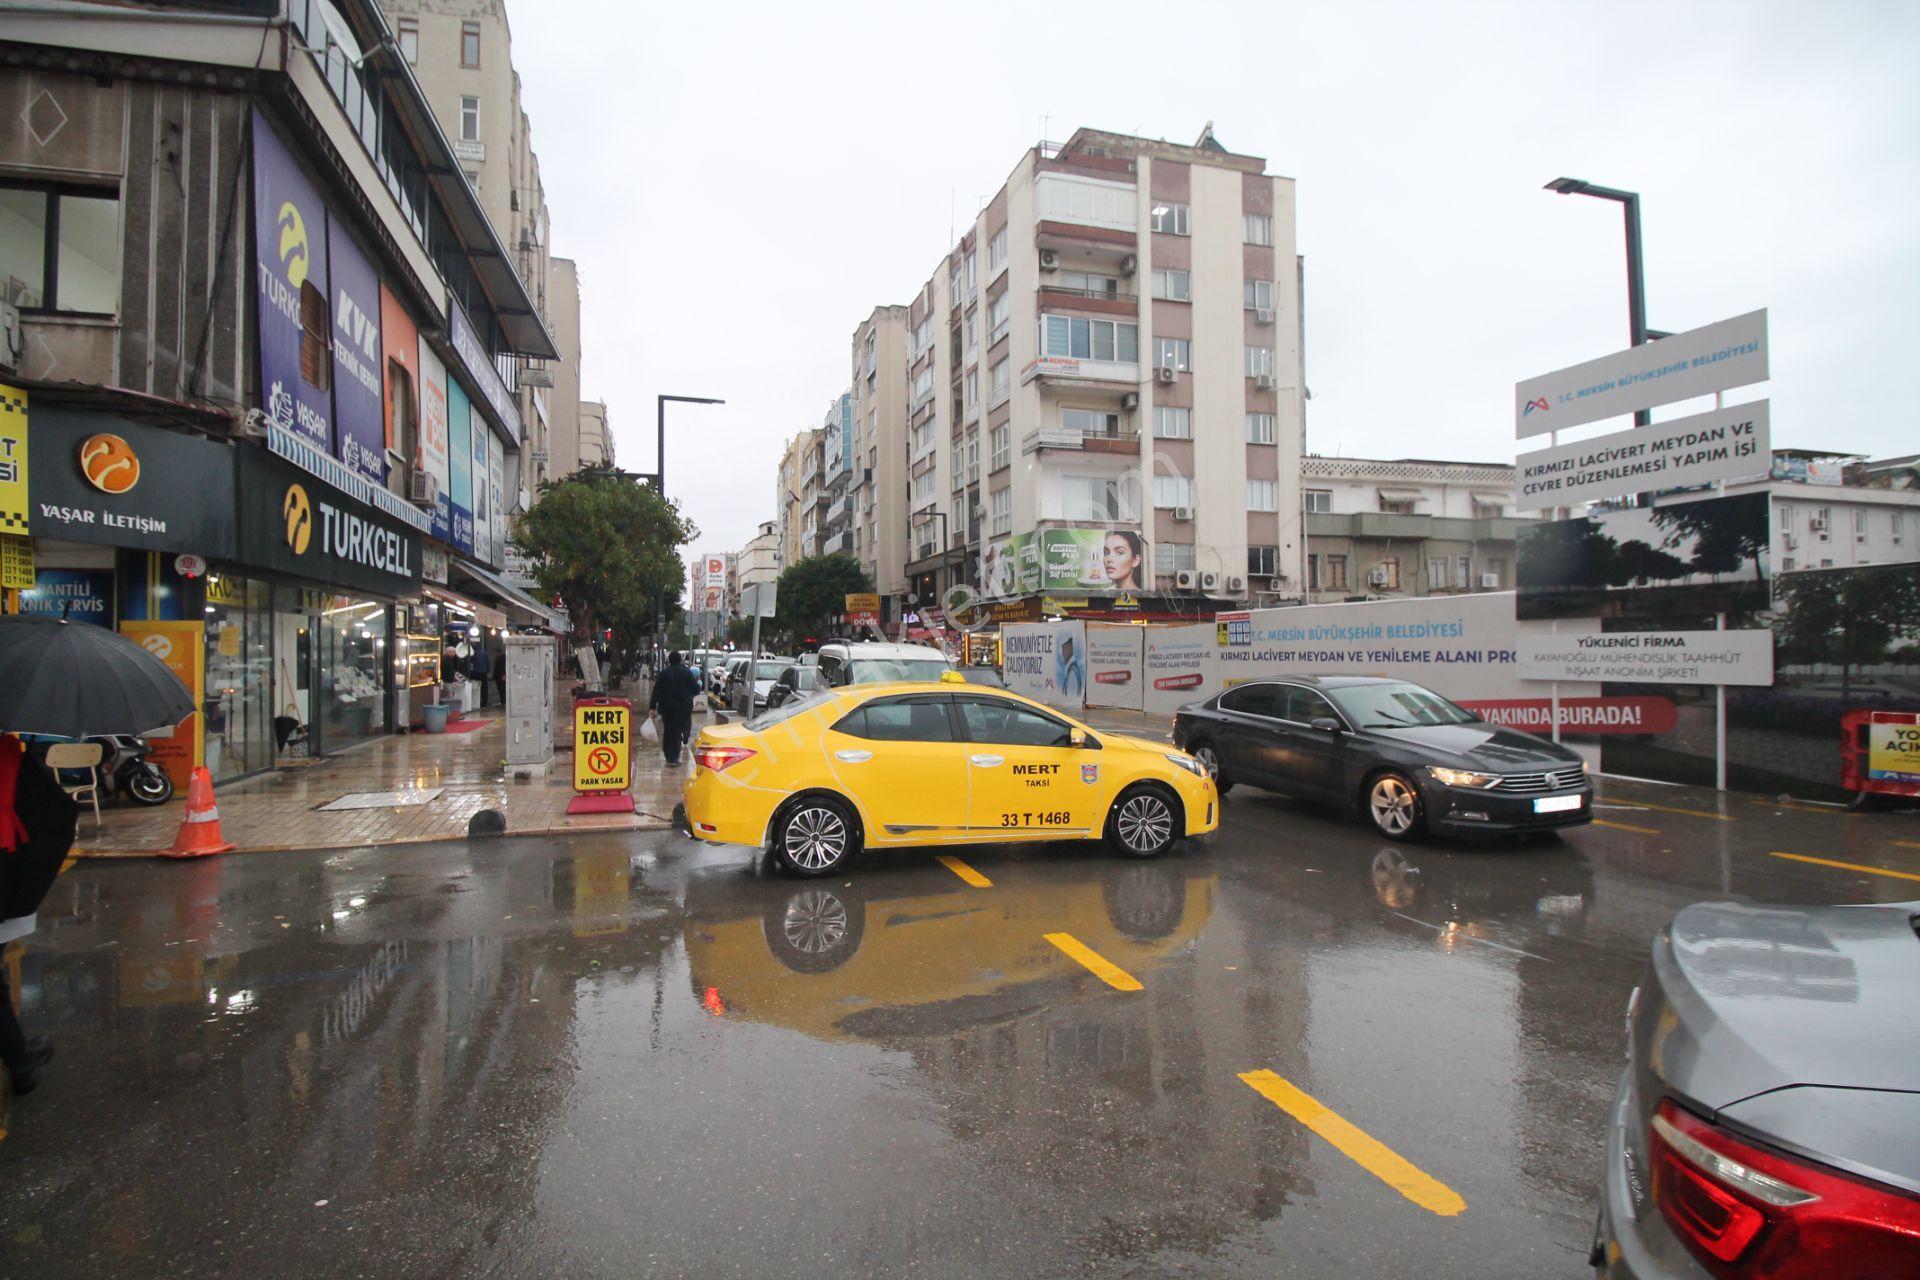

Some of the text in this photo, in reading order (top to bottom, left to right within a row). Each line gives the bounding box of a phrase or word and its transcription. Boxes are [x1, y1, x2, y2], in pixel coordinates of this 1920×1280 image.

[337, 288, 378, 362] KVK
[1577, 380, 1616, 399] MERSİN
[1618, 359, 1689, 388] BÜYÜKŞEHİR
[1692, 341, 1760, 369] BELEDİYESİ
[296, 400, 327, 440] YAŞAR
[1524, 421, 1755, 478] KIRMIZI LACİVERT MEYDAN VE
[1523, 437, 1757, 497] ÇEVRE DÜZENLEMESİ YAPIM İŞİ
[40, 503, 166, 534] YAŞAR İLETİŞİM
[319, 501, 412, 578] TURKCELL
[1268, 626, 1305, 641] MERSİN
[1308, 622, 1382, 643] BÜYÜKŞEHİR
[1387, 619, 1463, 638] BELEDİYESİ
[1006, 633, 1053, 654] MEMNUNİYETLE
[1577, 635, 1686, 648] YÜKLENİCİ FİRMA
[1220, 652, 1250, 661] KIRMIZI
[1252, 649, 1296, 662] LACİVERT
[1298, 651, 1344, 662] MEYDAN
[1348, 651, 1363, 661] VE
[1367, 648, 1431, 663] YENİLEME
[1434, 651, 1482, 663] ALANI
[1534, 651, 1742, 664] KAYANOĞLU MÜHENDİSLİK TAAHHÜT
[1006, 656, 1043, 678] ÇALIŞIYORUZ
[1565, 665, 1699, 679] İNŞAAT ANONİM ŞİRKETİ
[584, 710, 623, 725] MERT
[1480, 705, 1642, 725] YAKINDA BURADA!
[582, 727, 625, 745] TAKSİ
[1013, 764, 1061, 775] MERT
[581, 777, 624, 786] PARK YASAK
[1025, 778, 1050, 788] TAKSİ
[1001, 811, 1071, 827] 33 T 1468
